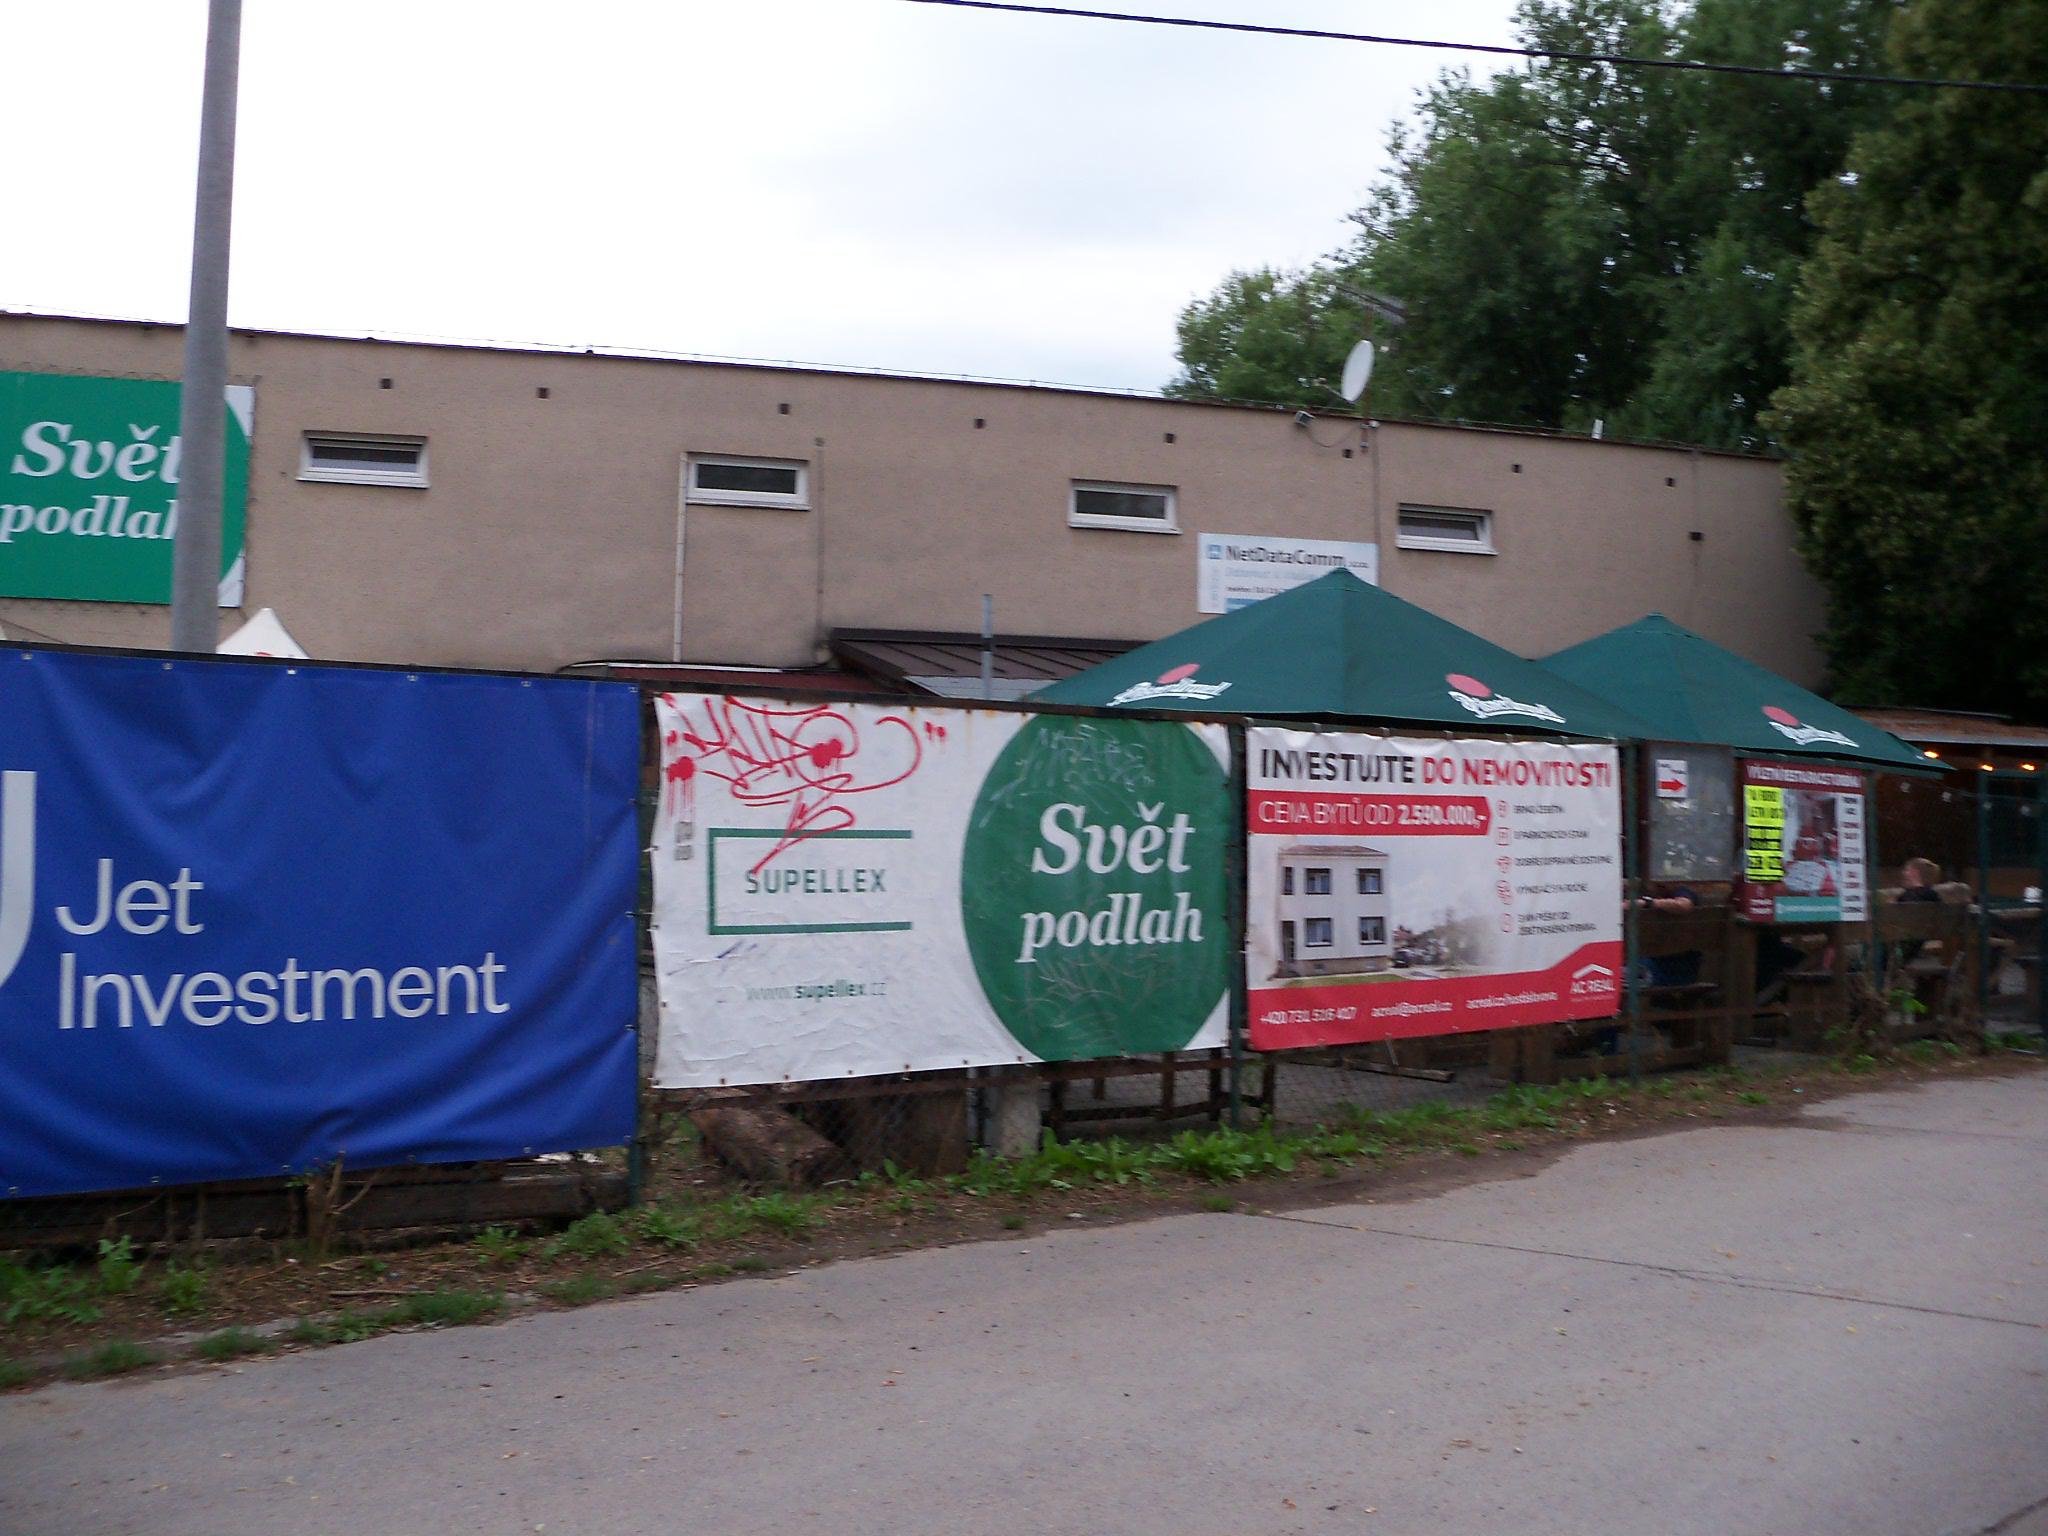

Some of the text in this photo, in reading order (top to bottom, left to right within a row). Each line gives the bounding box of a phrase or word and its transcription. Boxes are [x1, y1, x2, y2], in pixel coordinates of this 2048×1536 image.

[10, 421, 183, 484] Svět
[1260, 748, 1612, 788] INVESTUJTE DO NEMOVITOSTI
[1031, 801, 1197, 875] Svět
[1259, 801, 1311, 825] CENA
[1313, 798, 1365, 826] BYTŮ
[1366, 804, 1395, 826] OD
[55, 858, 205, 936] Jet
[745, 867, 888, 896] SUPELLEX
[1015, 891, 1205, 964] podlah
[58, 951, 510, 1030] Investment
